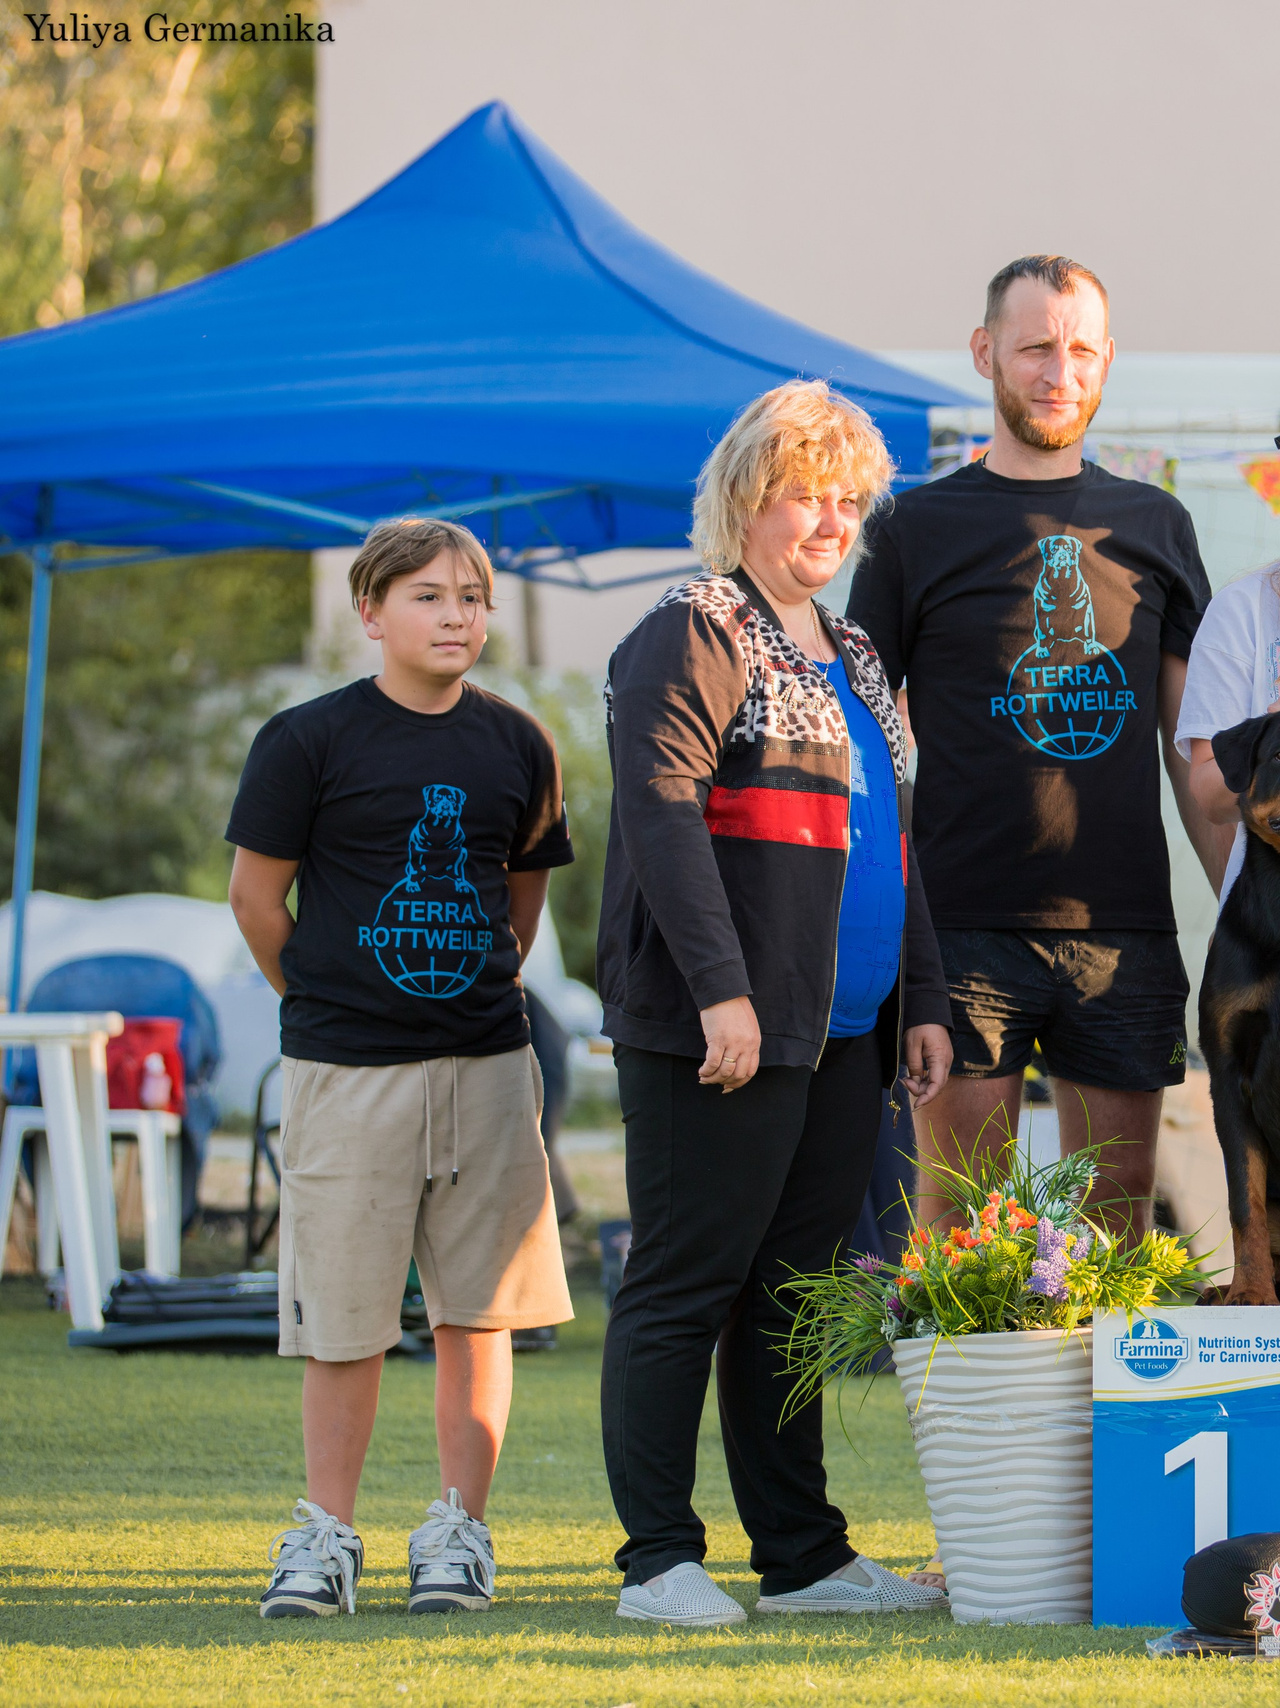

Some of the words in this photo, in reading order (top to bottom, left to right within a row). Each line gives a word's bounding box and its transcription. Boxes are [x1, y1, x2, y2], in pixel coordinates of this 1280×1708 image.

[1024, 664, 1111, 688] TERRA
[990, 690, 1138, 717] ROTTWEILER
[393, 901, 477, 924] TERRA
[358, 926, 493, 951] ROTTWEILER
[1120, 1341, 1183, 1357] Farmina
[1199, 1336, 1251, 1349] Nutrition
[1134, 1362, 1146, 1370] Pet
[1148, 1362, 1168, 1370] Foods
[1199, 1351, 1215, 1363] for
[1165, 1431, 1228, 1555] 1
